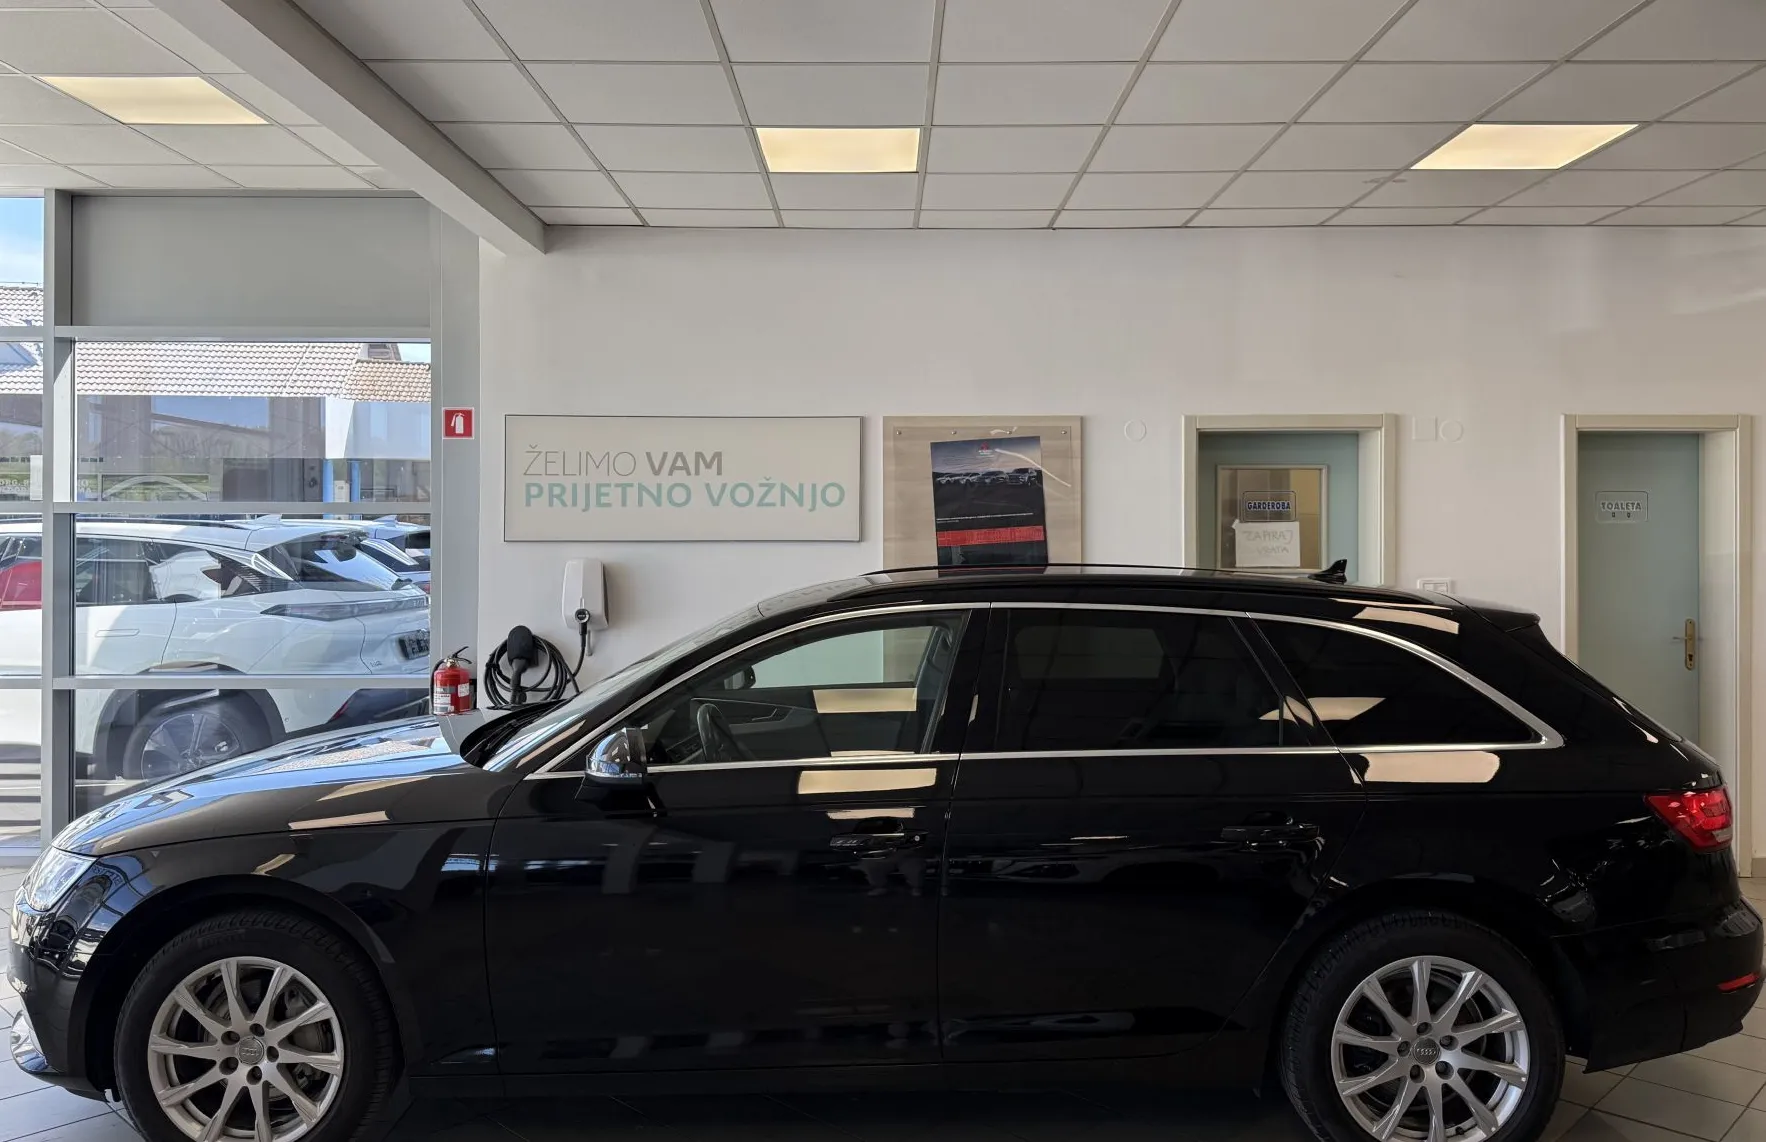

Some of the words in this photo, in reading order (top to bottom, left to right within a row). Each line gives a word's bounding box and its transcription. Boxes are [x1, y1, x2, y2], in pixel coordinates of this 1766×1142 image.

[523, 444, 637, 477] ŽELIMO
[645, 451, 723, 476] VAM
[525, 482, 692, 512] PRIJETNO
[704, 477, 845, 512] VOŽNJO
[1247, 501, 1291, 510] GARDEROBA
[1601, 502, 1642, 511] TOALETA
